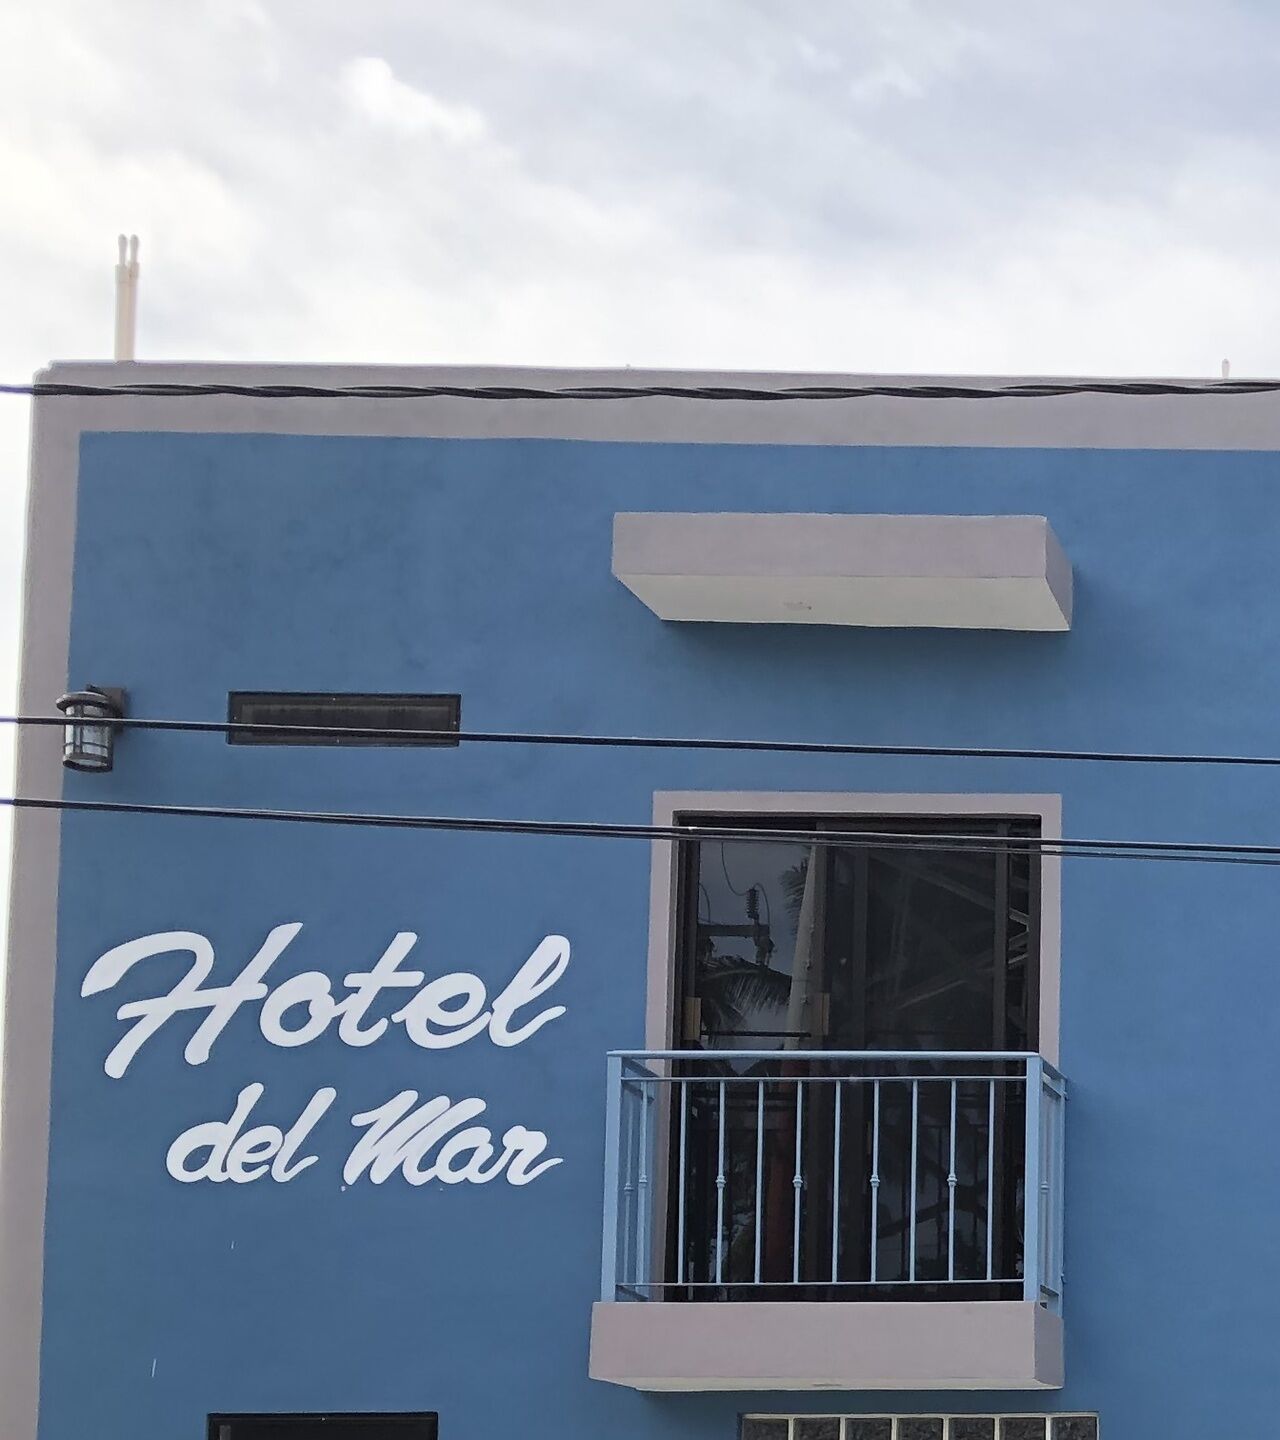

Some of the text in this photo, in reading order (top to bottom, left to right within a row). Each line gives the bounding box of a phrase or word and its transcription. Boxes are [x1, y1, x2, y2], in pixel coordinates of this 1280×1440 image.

[80, 921, 571, 1080] Hotel
[165, 1081, 564, 1187] del Mar
